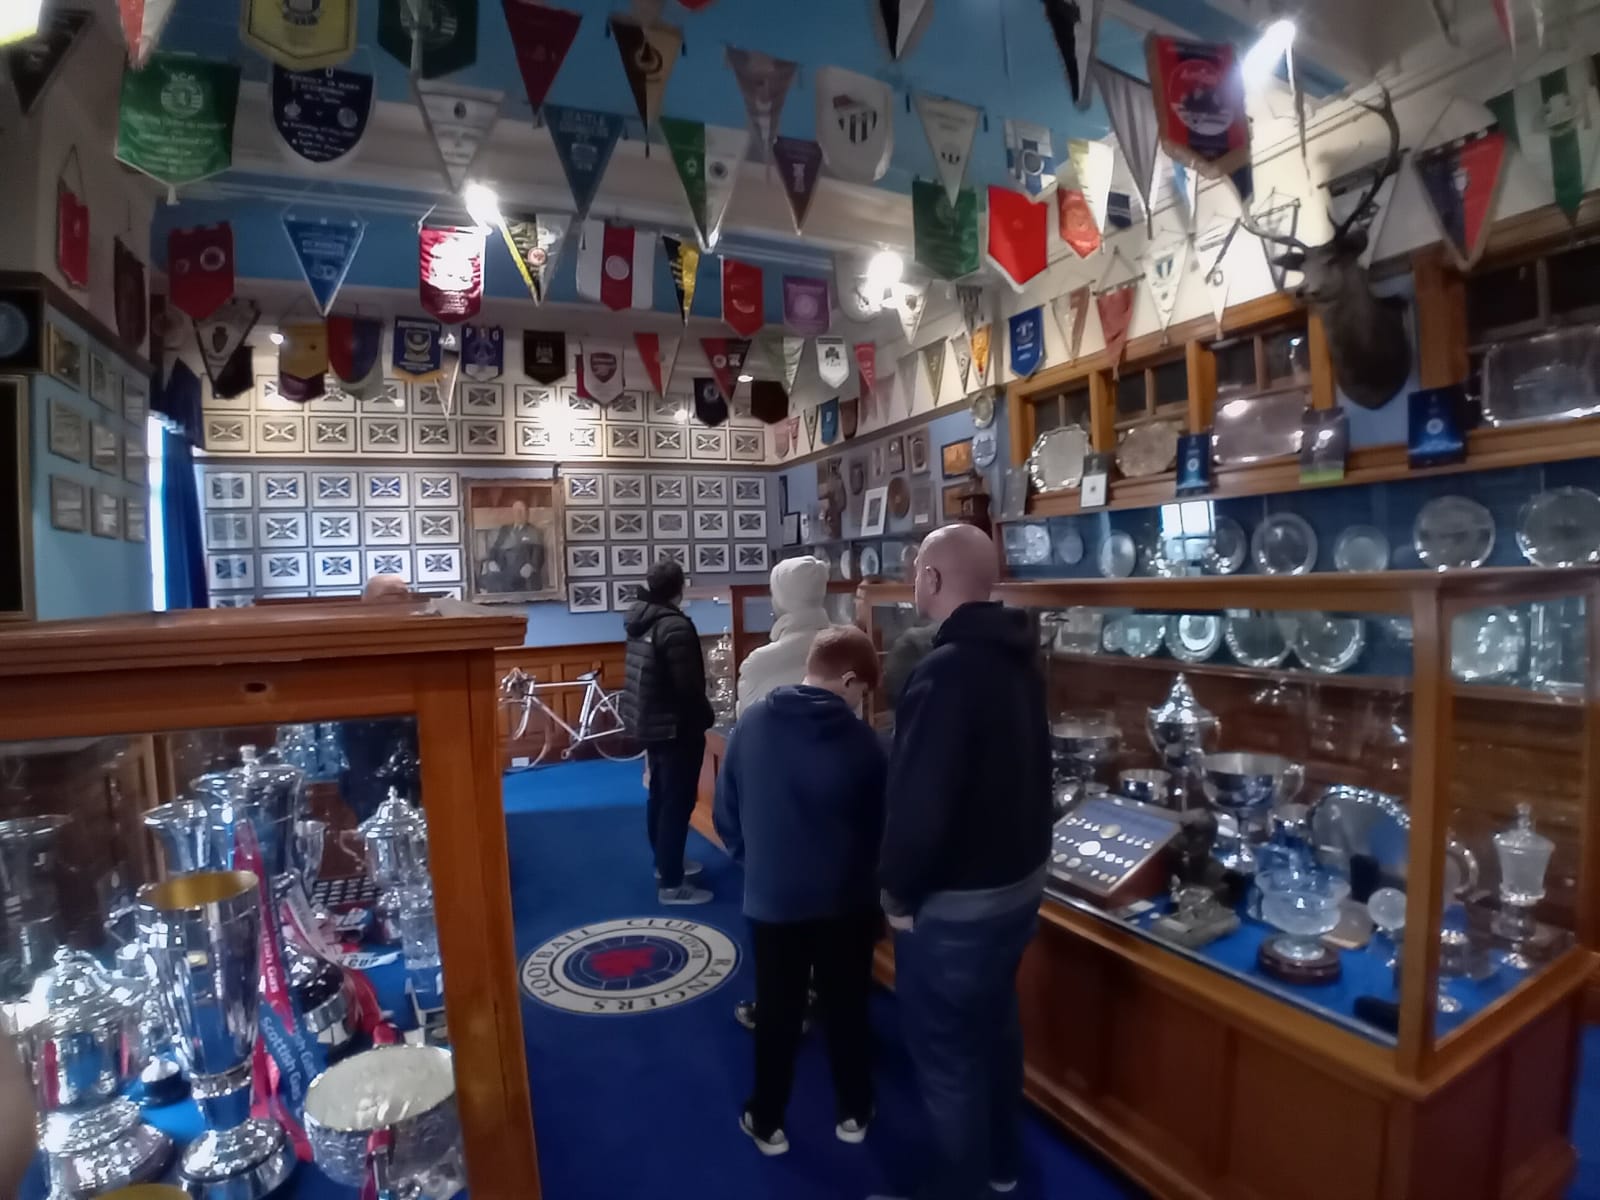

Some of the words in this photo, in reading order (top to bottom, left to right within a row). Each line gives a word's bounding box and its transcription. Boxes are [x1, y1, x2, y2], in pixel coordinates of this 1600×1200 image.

[626, 919, 699, 932] CLUB
[526, 929, 591, 998] FOOTBALL
[592, 957, 733, 1011] RANGERS
[260, 1016, 296, 1072] Scottish
[288, 1071, 302, 1101] Gas
